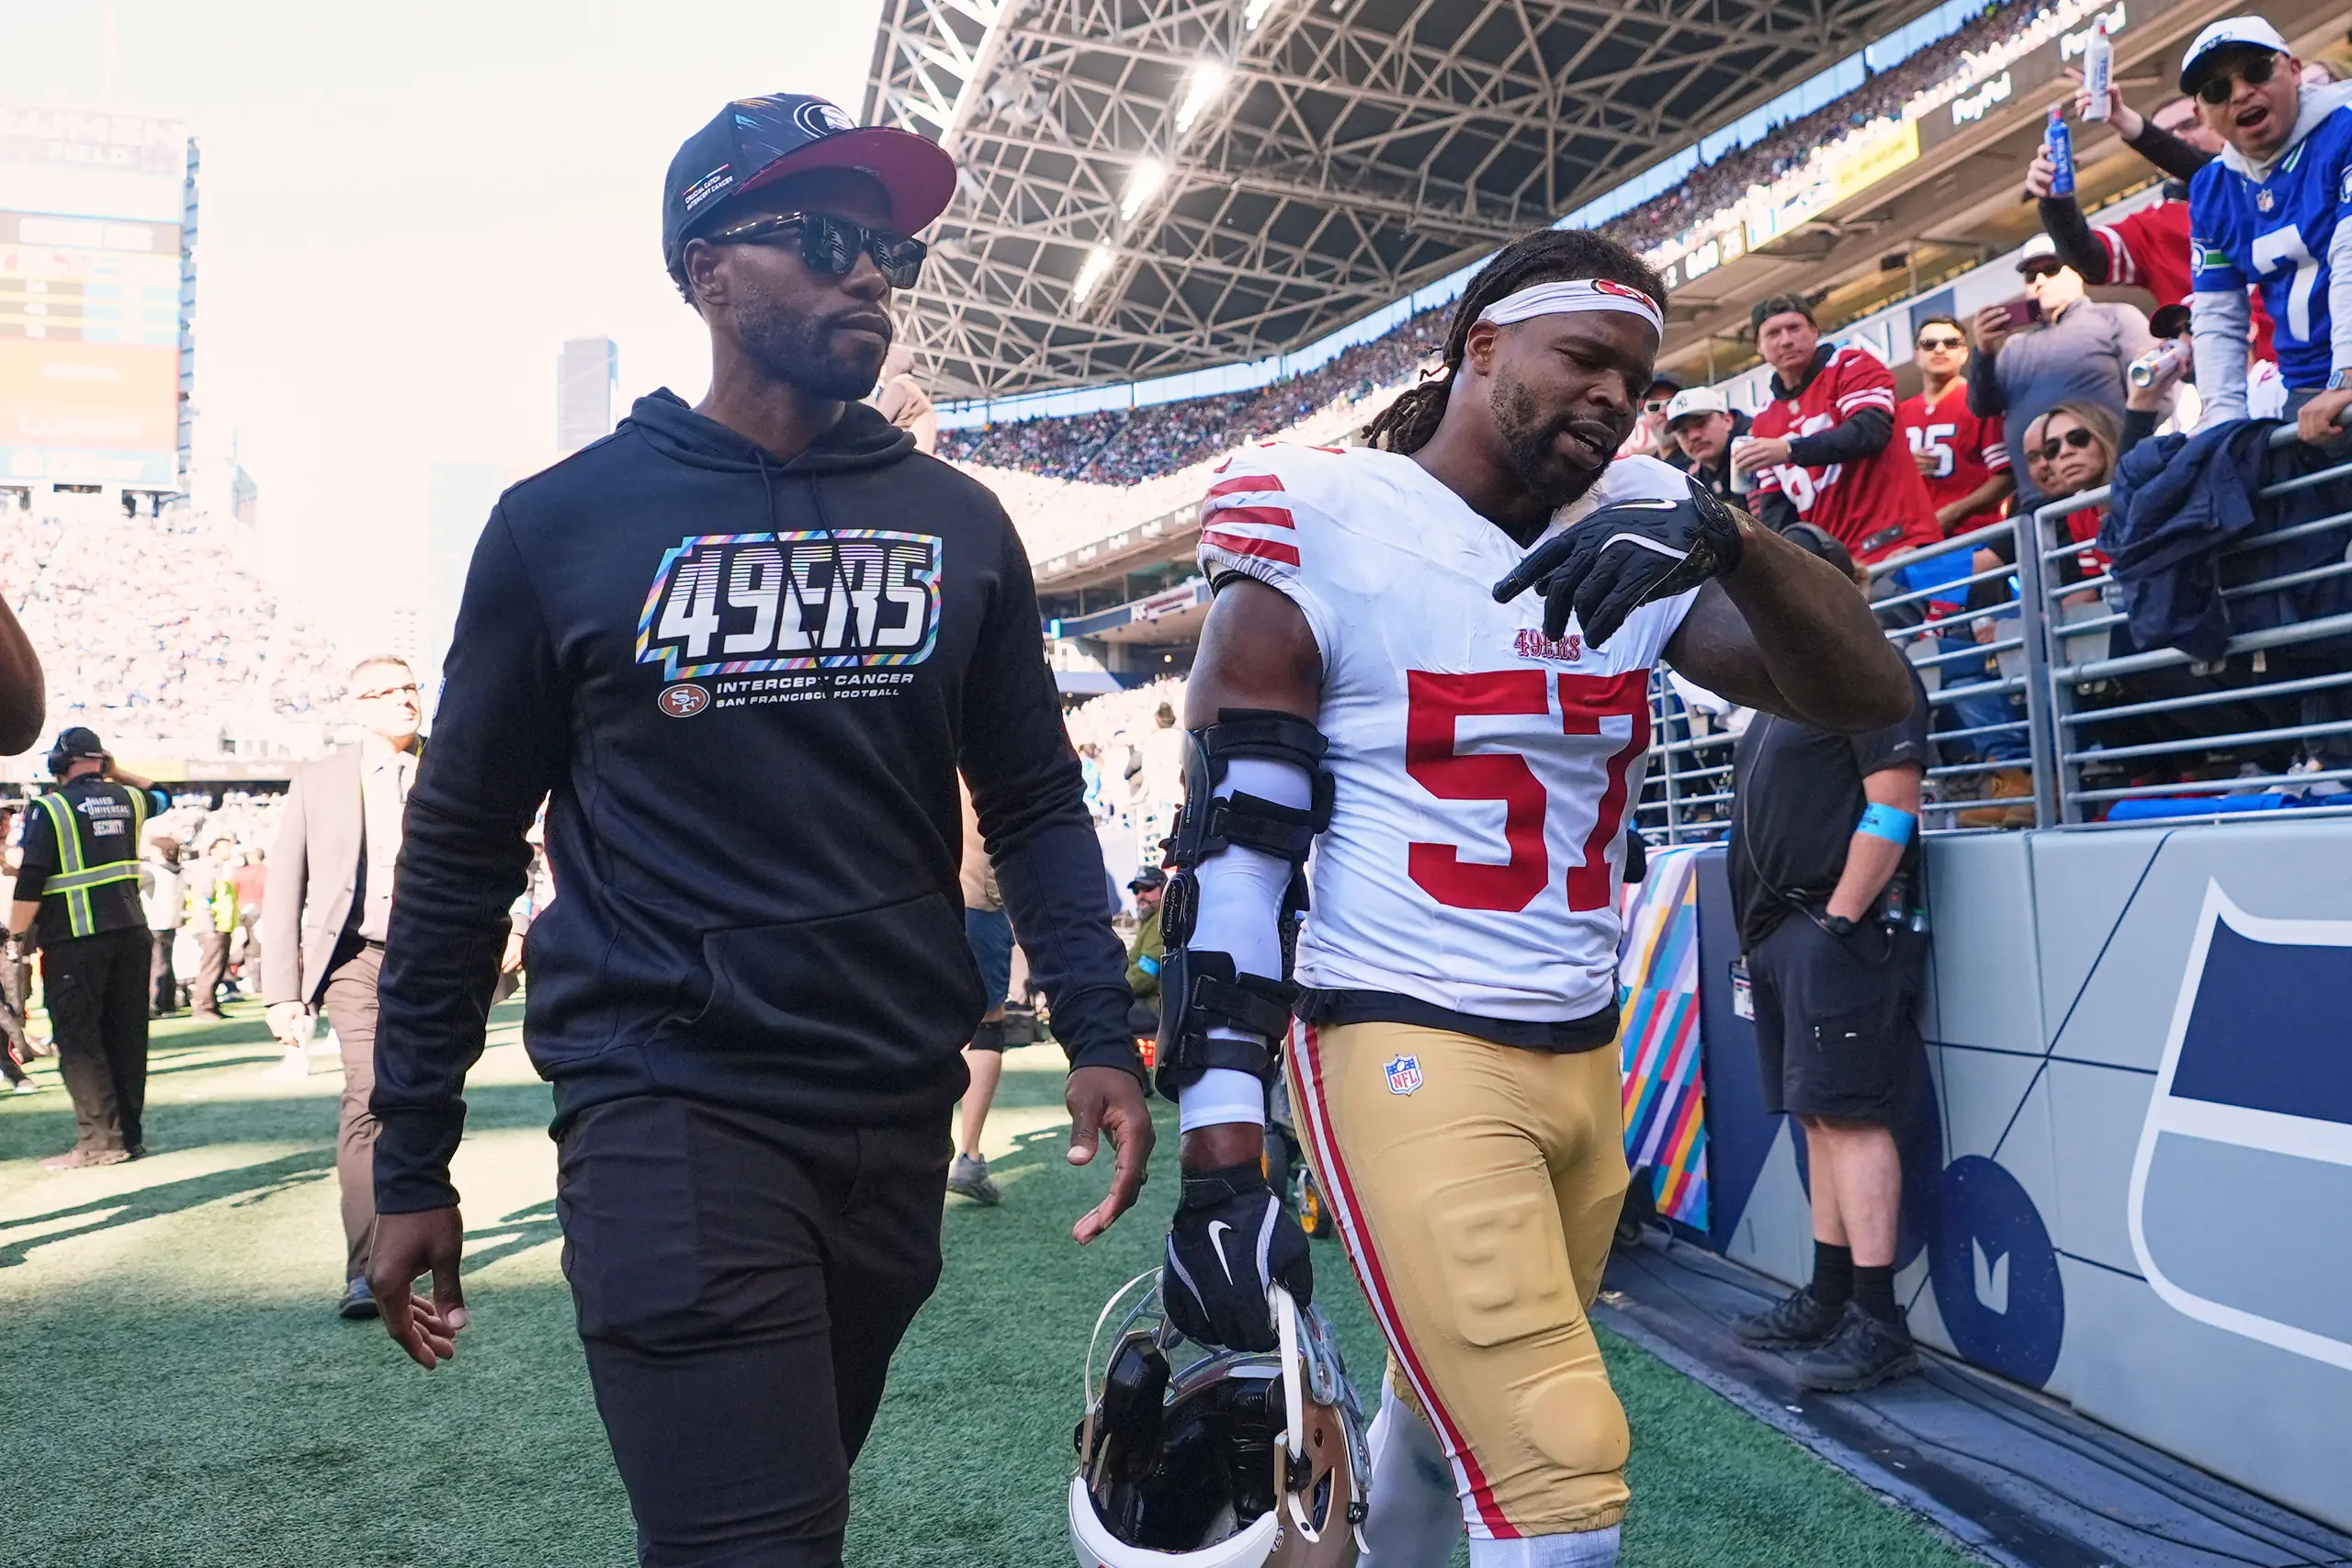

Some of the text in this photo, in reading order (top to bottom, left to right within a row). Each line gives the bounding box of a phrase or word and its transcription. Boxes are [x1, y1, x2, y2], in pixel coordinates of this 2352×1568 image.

[2060, 1, 2126, 62] Paal
[703, 175, 721, 189] CATCH
[711, 175, 733, 192] CANCER
[2252, 223, 2319, 342] 7
[657, 544, 927, 659] 49ERS
[834, 673, 914, 686] CANCER
[716, 697, 746, 708] SAN
[833, 689, 899, 699] FOOTBALL
[1406, 668, 1651, 913] 57
[88, 804, 130, 817] UNIVERSAL
[92, 819, 126, 837] SECURITY
[1392, 1070, 1418, 1089] NFL
